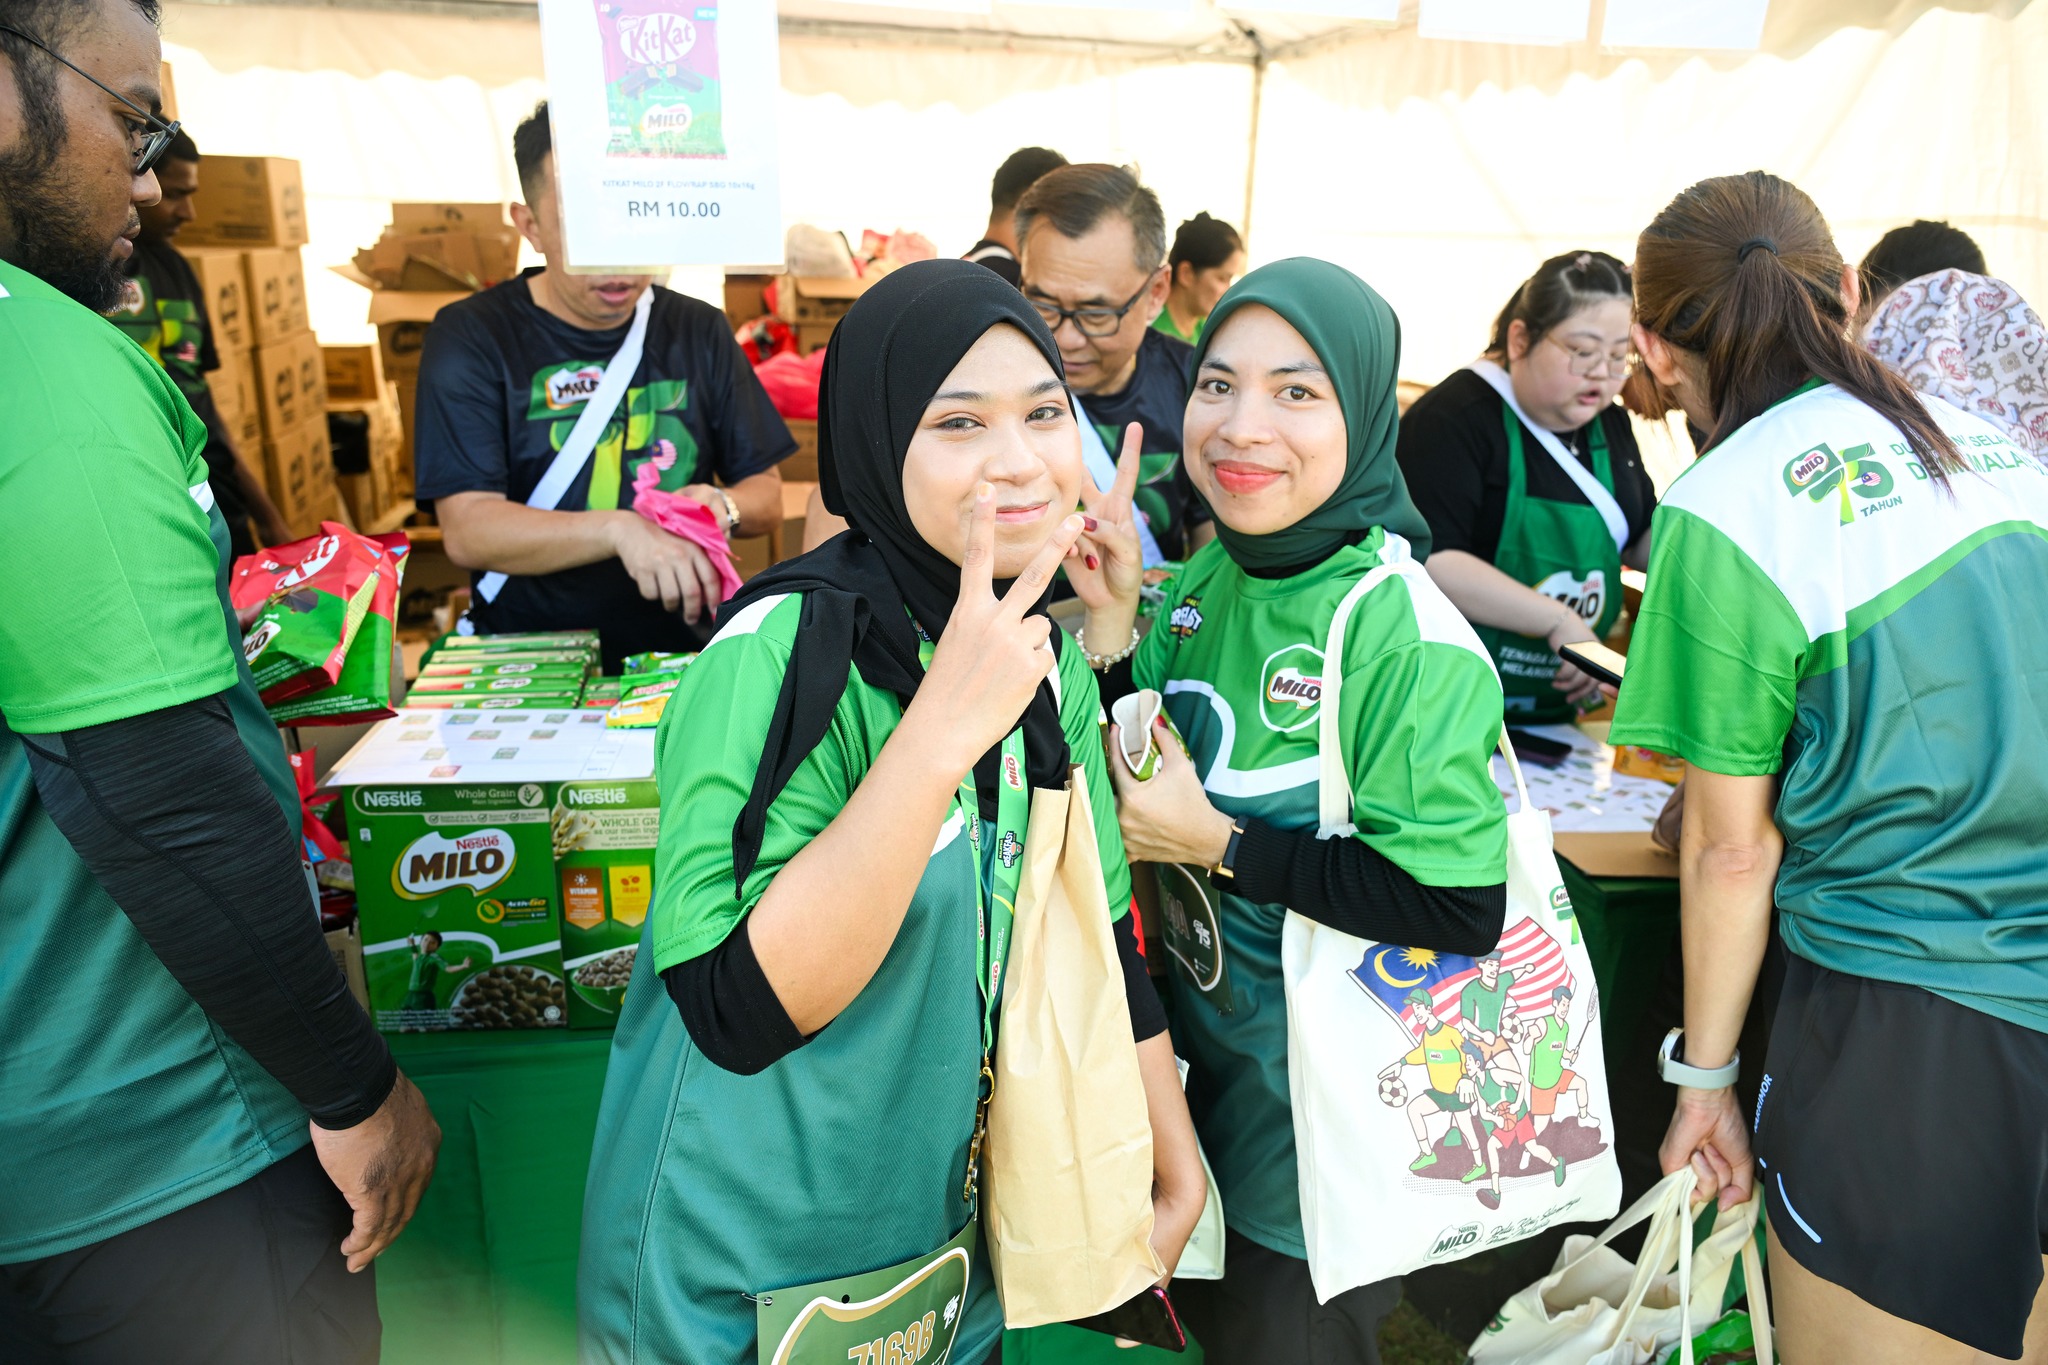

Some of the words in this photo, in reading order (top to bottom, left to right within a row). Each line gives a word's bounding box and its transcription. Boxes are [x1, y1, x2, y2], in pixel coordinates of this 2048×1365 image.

[629, 15, 692, 63] KitKat
[647, 113, 687, 129] MILO
[602, 180, 630, 188] KITKAT
[629, 201, 660, 217] RM
[667, 202, 720, 217] 10.00
[1795, 455, 1825, 480] MILO
[1860, 496, 1903, 517] TAHUN
[1272, 676, 1321, 701] MILO
[1009, 757, 1019, 786] MILO
[363, 790, 422, 807] Nestlé
[455, 789, 486, 799] Whole
[488, 788, 516, 799] Grain
[568, 788, 627, 805] Nestlé
[600, 817, 639, 827] WHOLE
[456, 835, 499, 850] Nestlé
[1003, 831, 1014, 868] BREAKFAST
[409, 848, 504, 884] MILO
[1433, 1231, 1477, 1254] MILO
